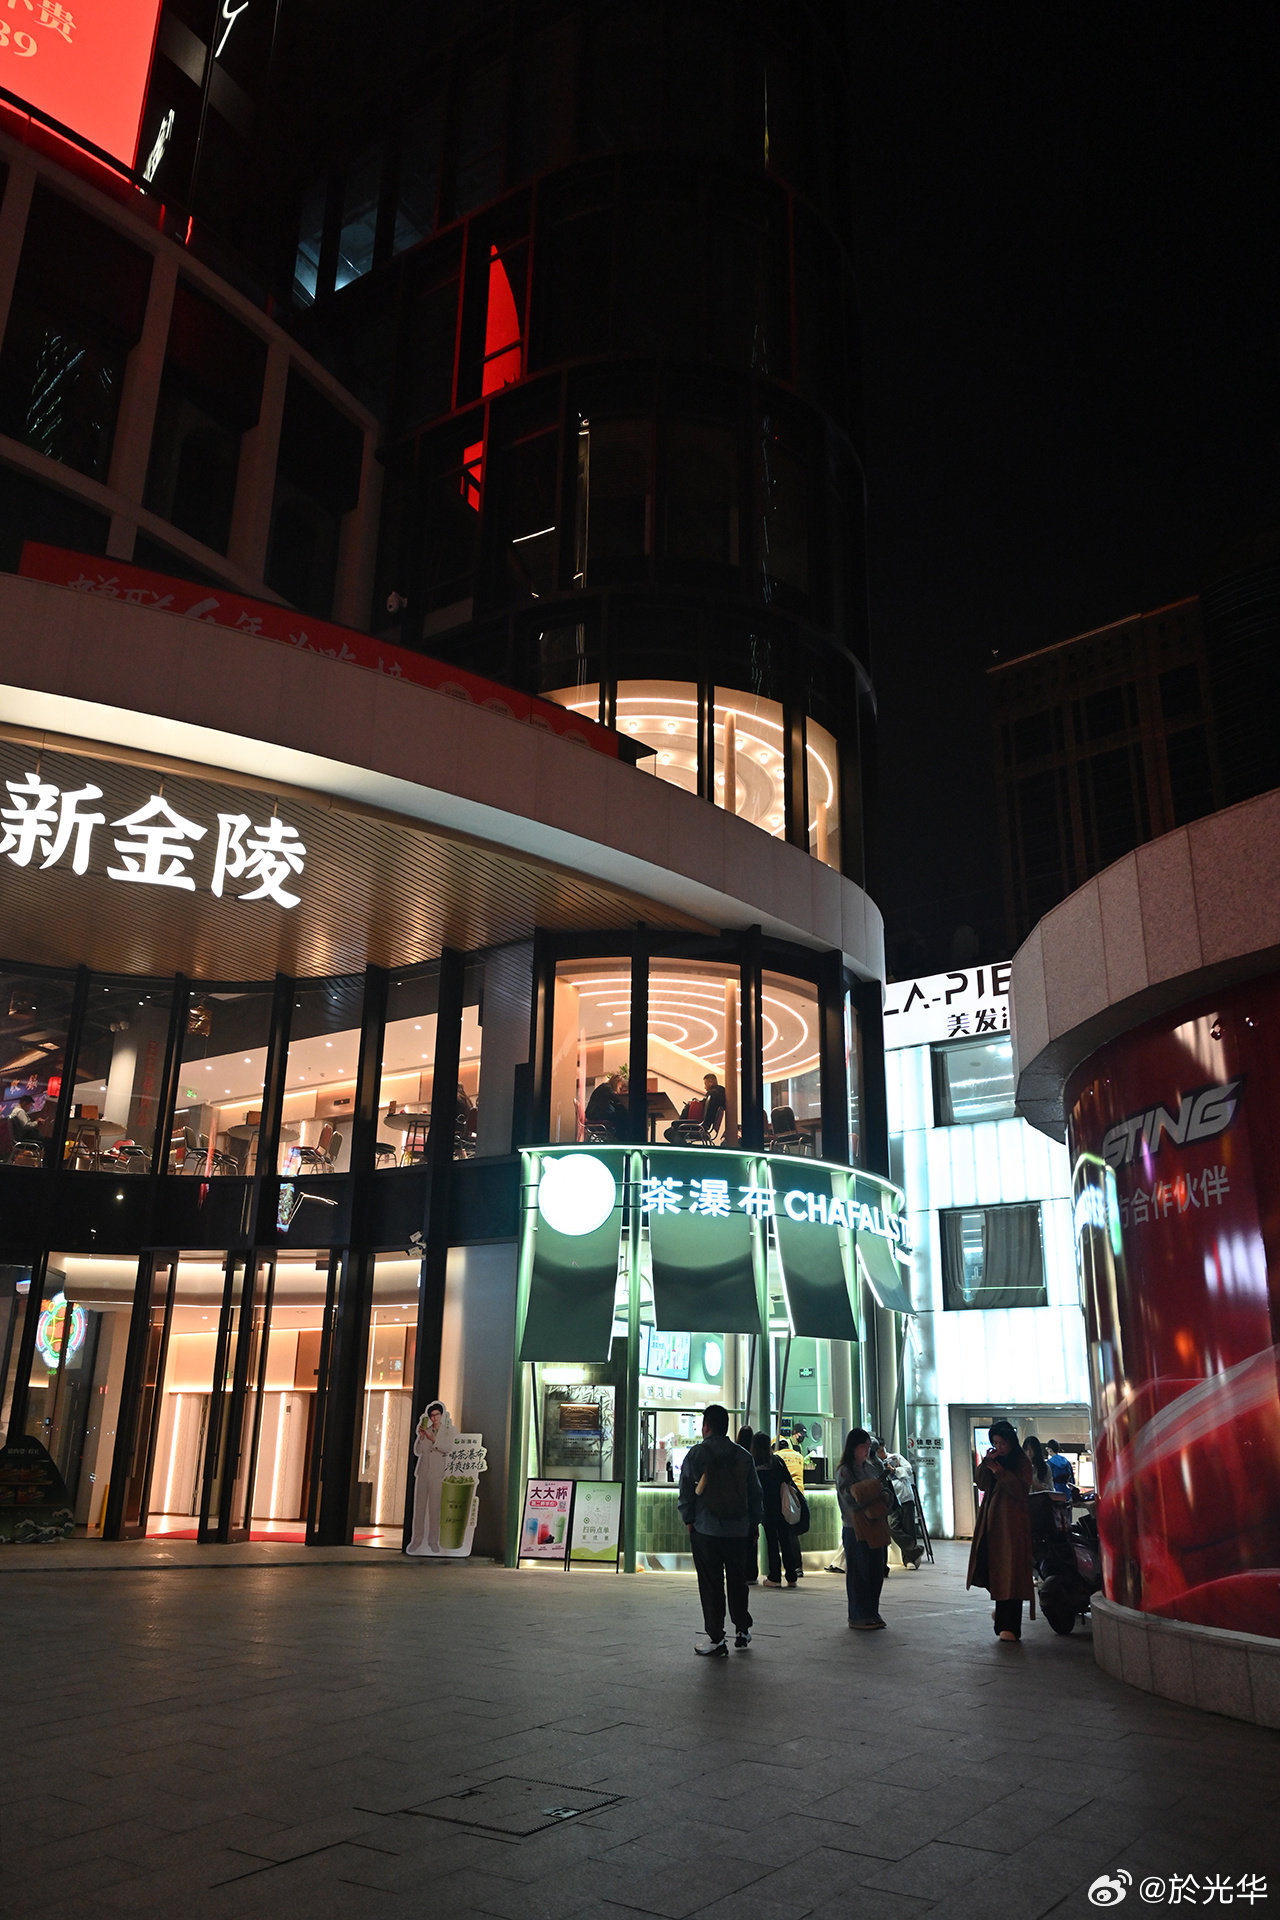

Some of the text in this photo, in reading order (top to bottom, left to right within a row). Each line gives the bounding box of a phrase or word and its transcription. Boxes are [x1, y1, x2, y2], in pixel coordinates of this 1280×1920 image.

[0, 773, 308, 909] 新金陵
[1102, 1081, 1241, 1168] STING
[639, 1176, 777, 1220] 茶瀑布
[530, 1486, 568, 1500] 大大杯
